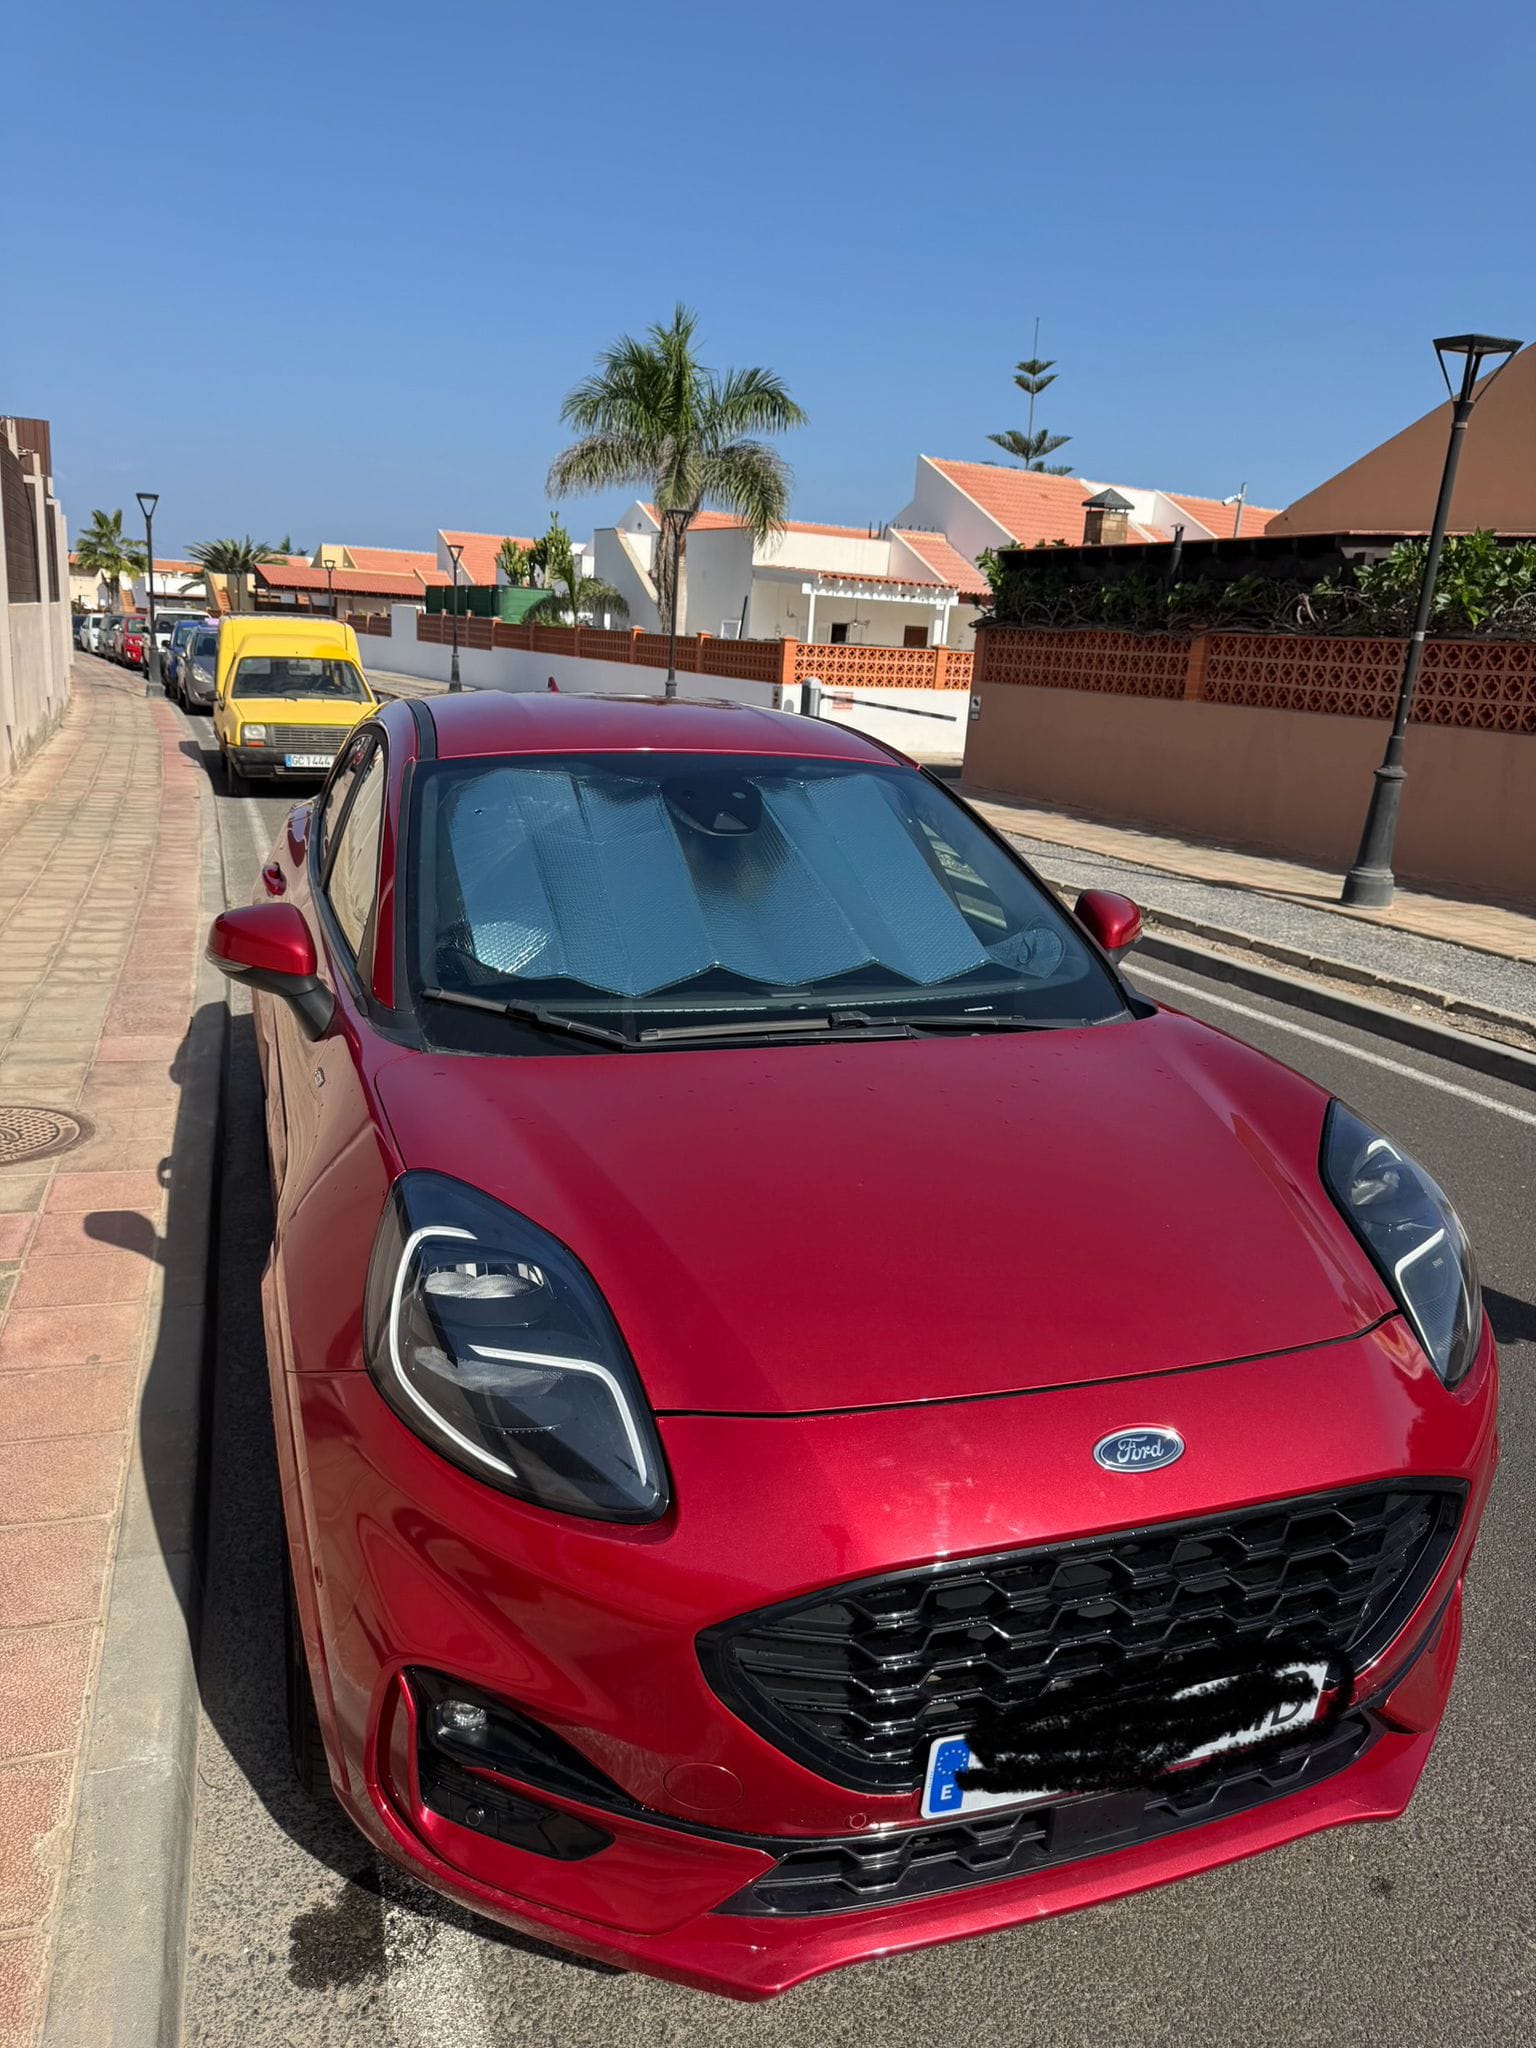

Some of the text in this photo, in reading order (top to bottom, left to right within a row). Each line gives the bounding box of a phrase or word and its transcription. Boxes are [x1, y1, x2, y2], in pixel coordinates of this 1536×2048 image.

[292, 755, 304, 765] GC
[1117, 1435, 1164, 1463] Ford
[940, 1783, 954, 1800] E
